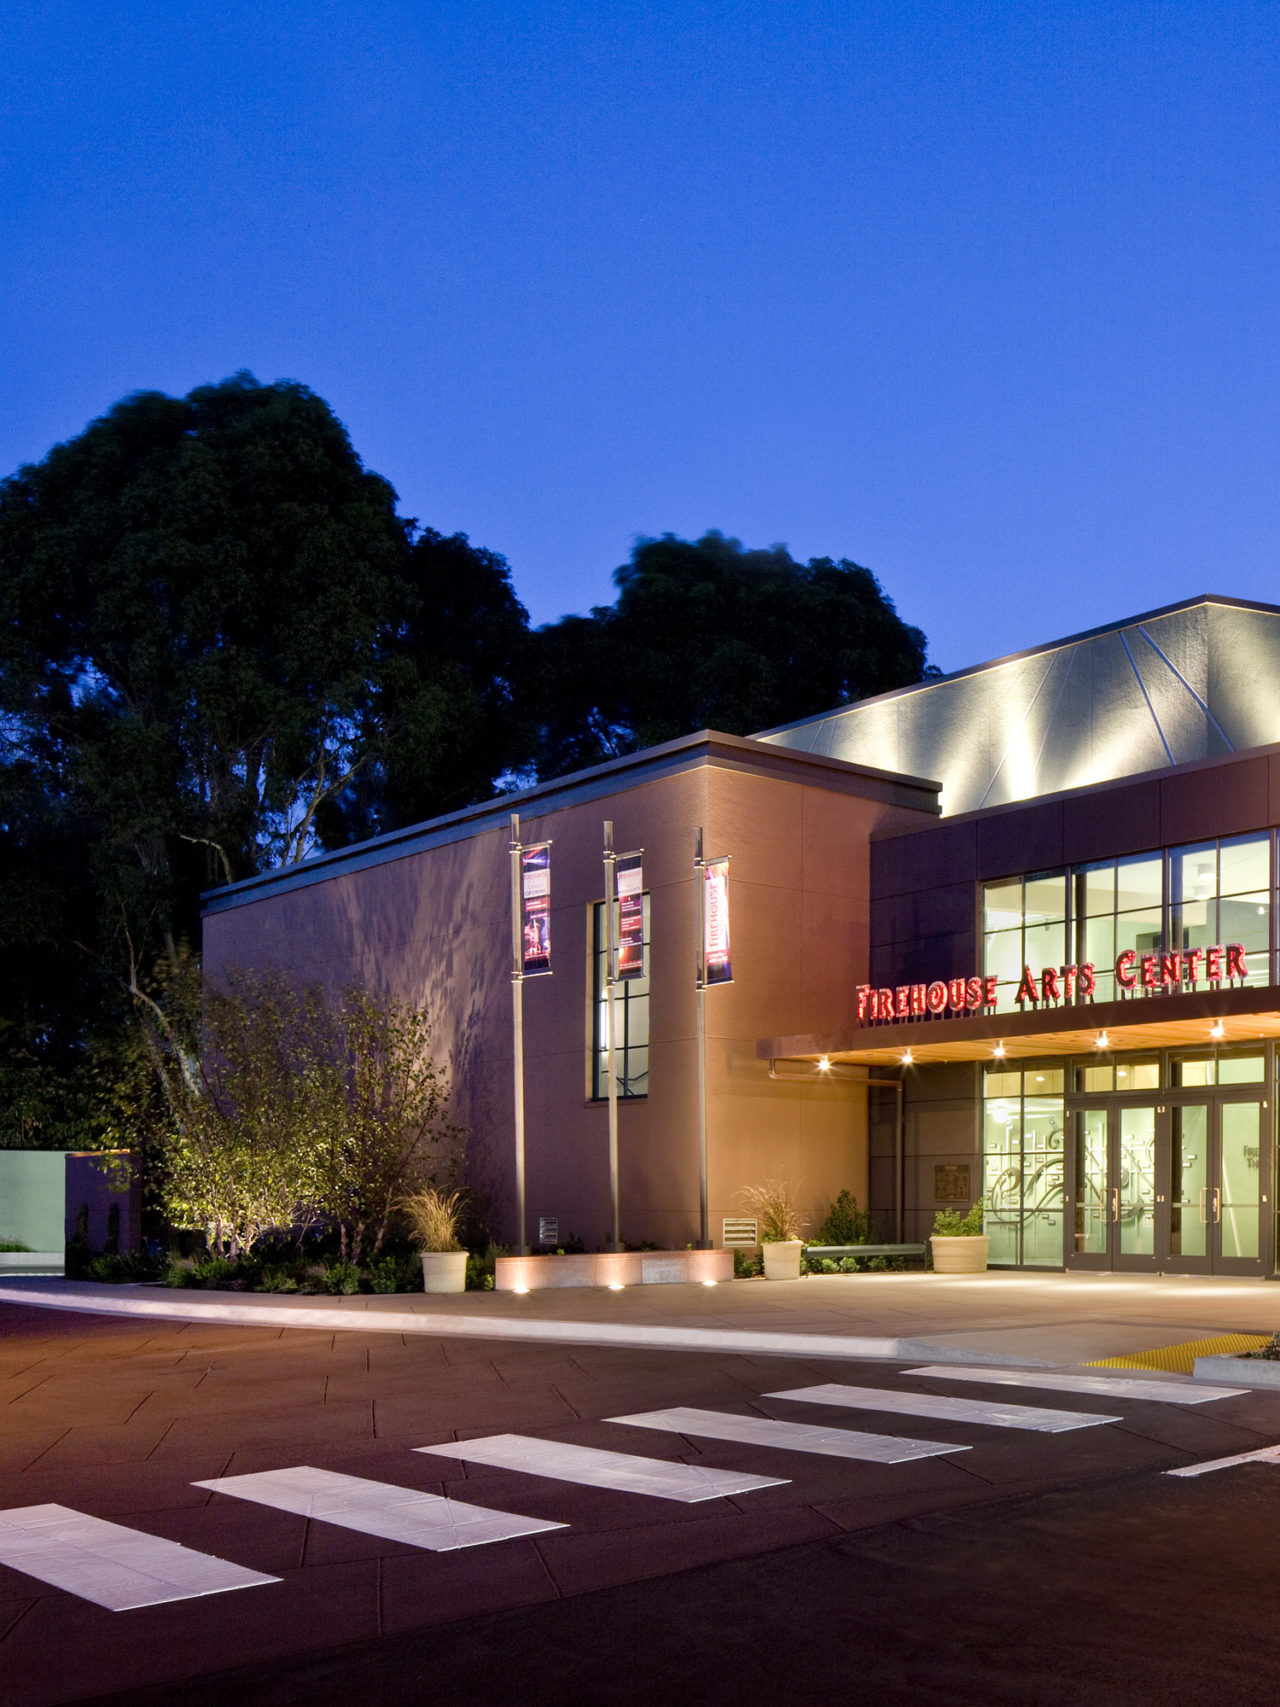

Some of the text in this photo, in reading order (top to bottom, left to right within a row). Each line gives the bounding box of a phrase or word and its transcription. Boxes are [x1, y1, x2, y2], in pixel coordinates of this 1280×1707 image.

[709, 884, 719, 947] FIREHOUSE
[855, 942, 1249, 1022] FIREHOUSE ARTS CENTER
